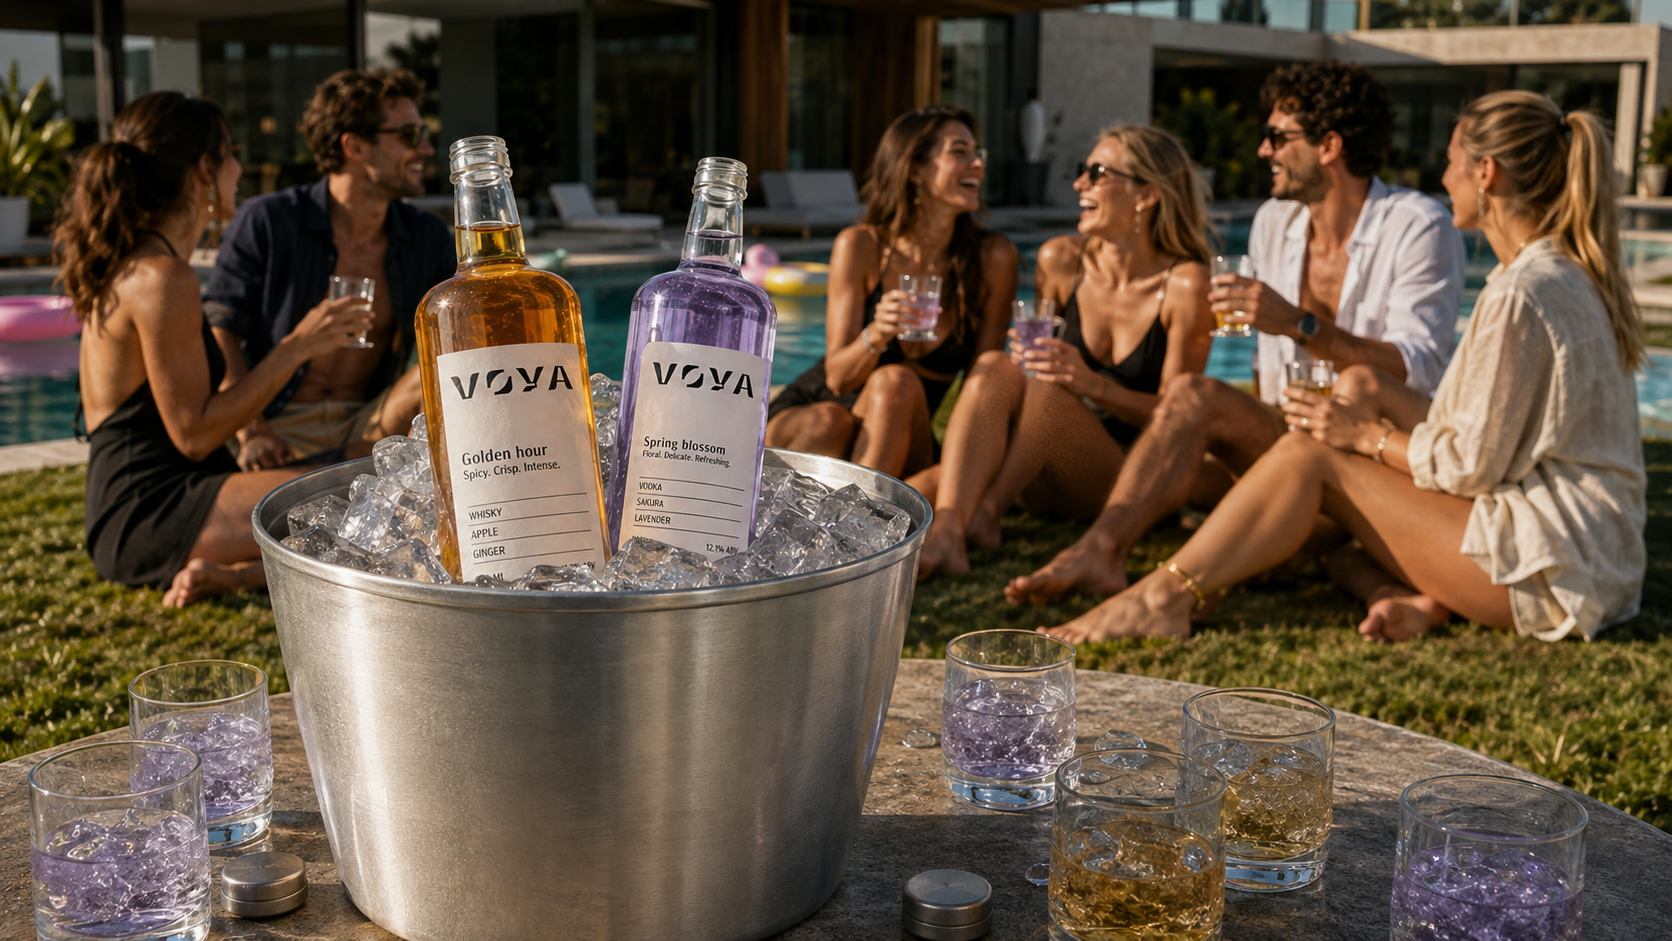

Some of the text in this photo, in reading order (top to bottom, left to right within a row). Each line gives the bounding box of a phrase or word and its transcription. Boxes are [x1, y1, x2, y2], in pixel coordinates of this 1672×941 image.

[451, 366, 573, 400] VOYA
[653, 362, 754, 398] VOYA
[643, 436, 726, 455] Spring blossom
[462, 446, 548, 466] Golden hour
[463, 461, 561, 481] Spicy. Crisp. Intense.
[636, 498, 664, 508] SAKURA
[468, 508, 502, 521] WHISKY
[471, 527, 498, 540] APPLE
[473, 546, 506, 559] GINGER
